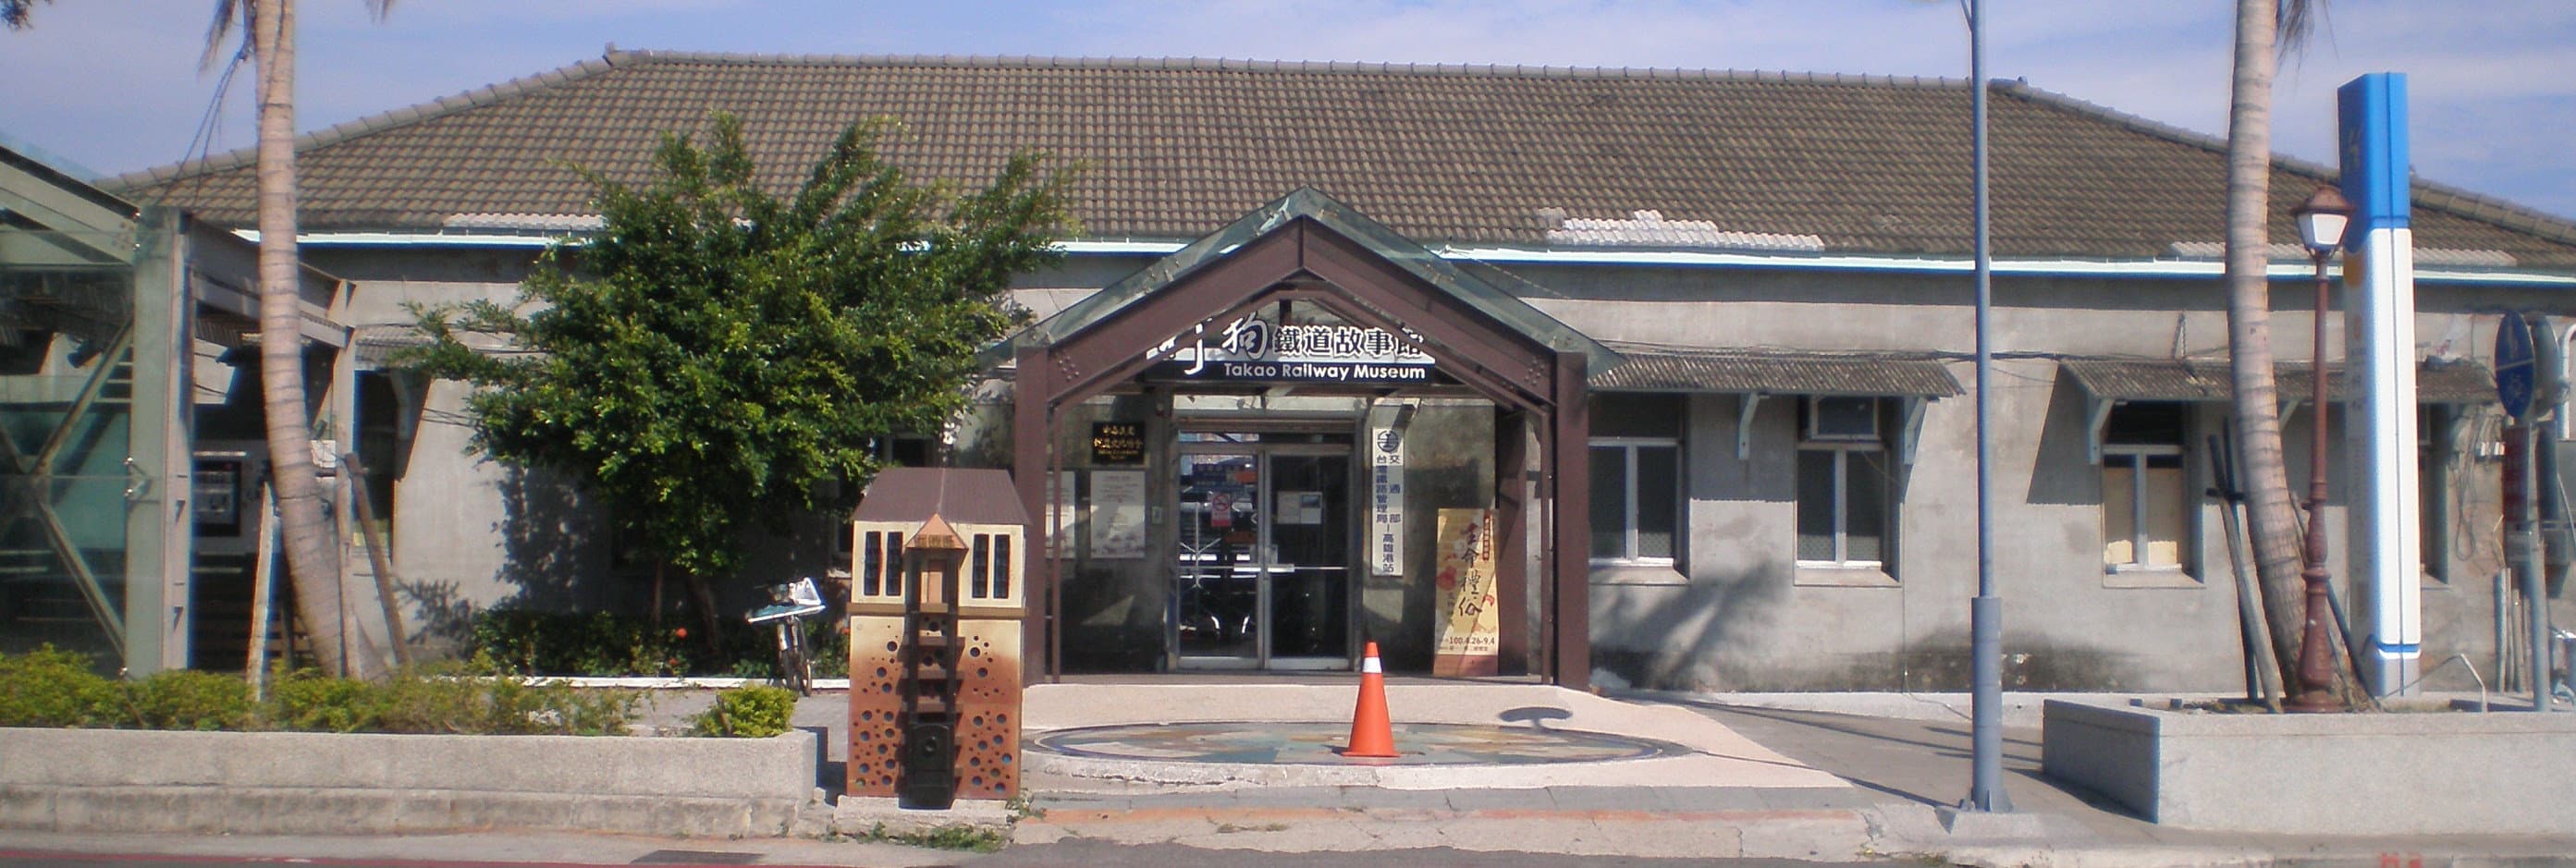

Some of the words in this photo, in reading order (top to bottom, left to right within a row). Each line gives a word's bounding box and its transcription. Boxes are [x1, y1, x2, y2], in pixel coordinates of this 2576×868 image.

[1224, 362, 1276, 377] Takao
[1282, 362, 1349, 381] Railway
[1354, 364, 1426, 379] Museum
